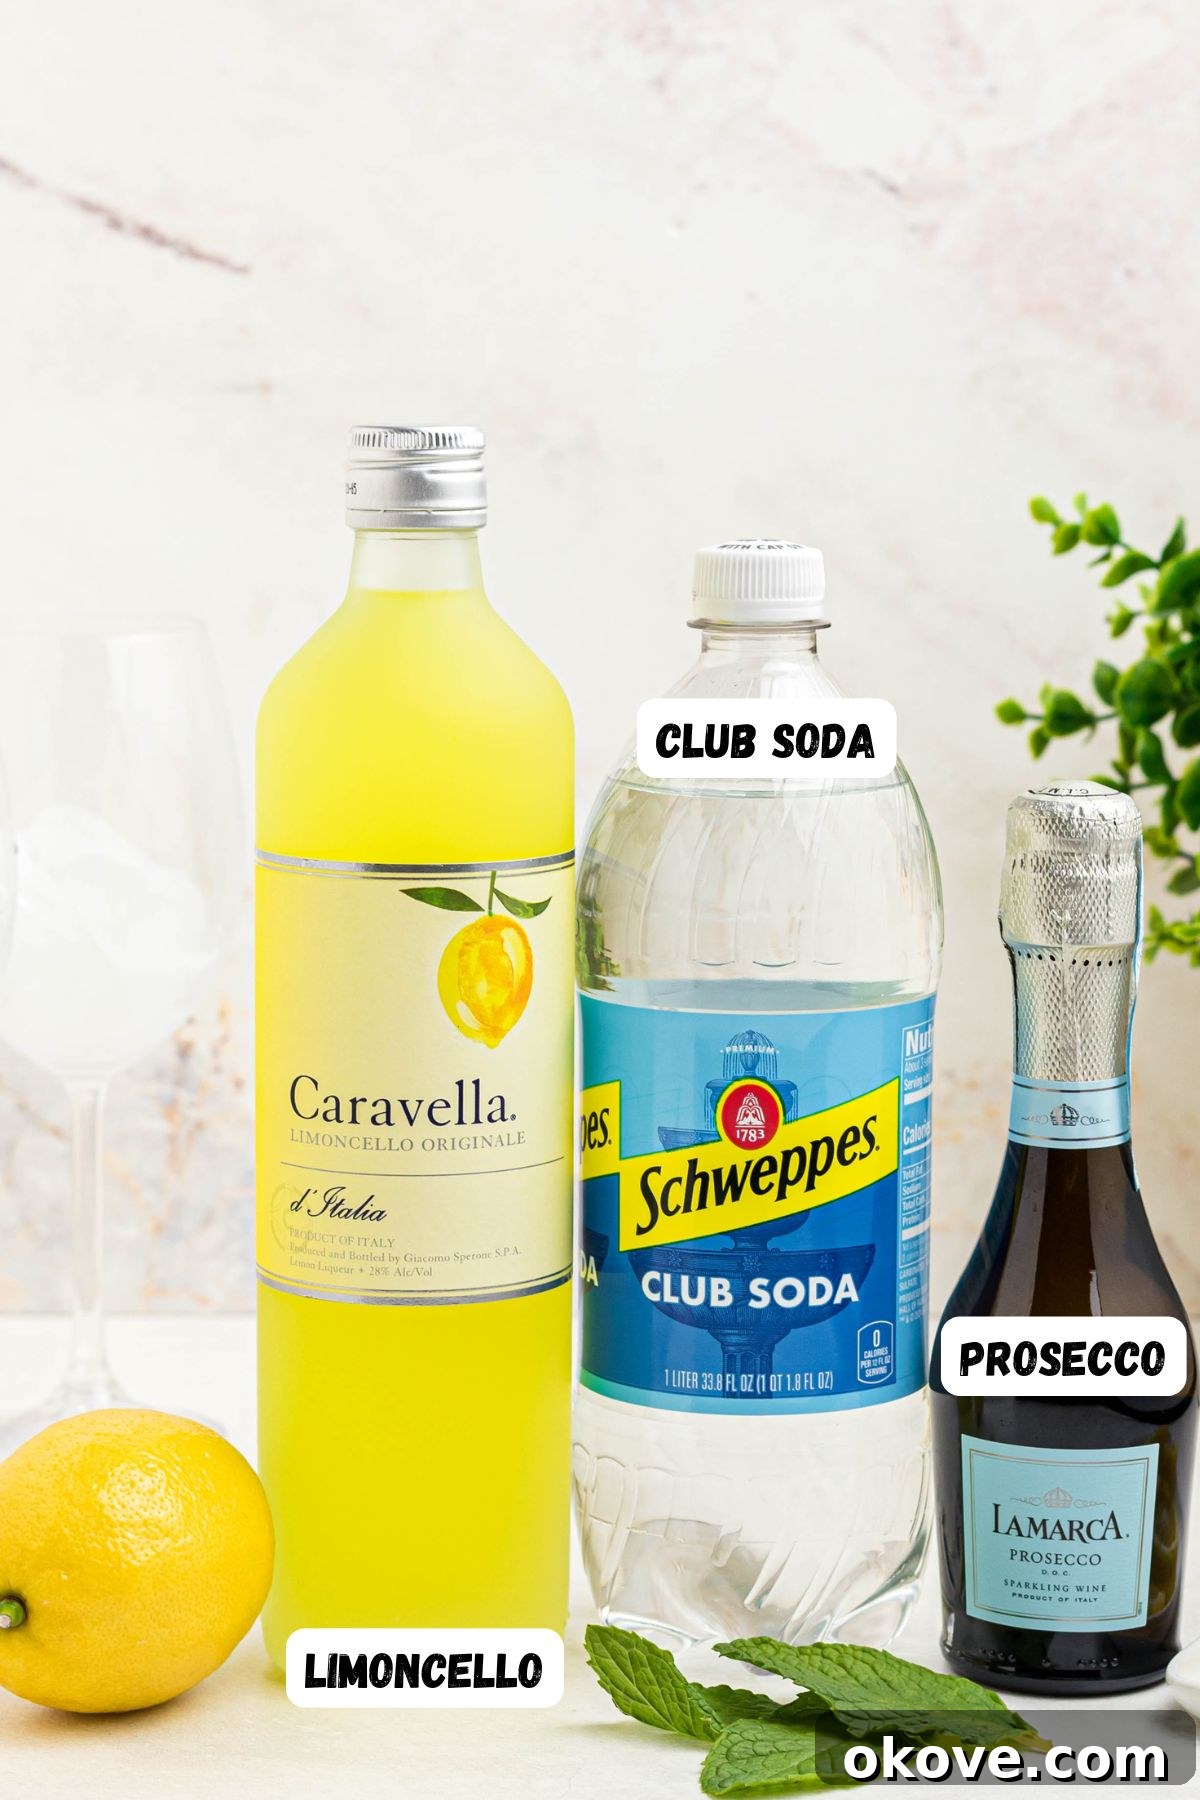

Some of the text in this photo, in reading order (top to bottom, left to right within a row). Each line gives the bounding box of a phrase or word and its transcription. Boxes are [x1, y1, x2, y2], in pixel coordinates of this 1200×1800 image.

[725, 1044, 775, 1055] PREMIUM
[290, 1128, 526, 1152] LIMONCELLO ORIGINALE
[736, 1128, 765, 1142] 1783
[636, 1115, 877, 1236] Schweppes
[289, 1227, 396, 1249] PRODUCT OF ITALY
[289, 1241, 523, 1266] Produced and Bottled by Giacomo Sperone S.P.A.
[289, 1256, 433, 1278] Lemon Liqueur 28% Alc/Vol
[641, 1271, 733, 1307] CLUB
[747, 1273, 859, 1308] SODA
[873, 1329, 880, 1347] 0
[861, 1355, 891, 1368] PER 12 FL OZ
[863, 1347, 888, 1359] CALORIES
[865, 1366, 888, 1377] SERVING
[664, 1369, 833, 1394] 1 LITER 33.8 FL OZ (1 QT 1.8 FL OZ)
[1009, 1549, 1102, 1566] PROSECCO
[1003, 1578, 1107, 1592] SPARKLING WINE
[1011, 1592, 1053, 1603] PRODUCT
